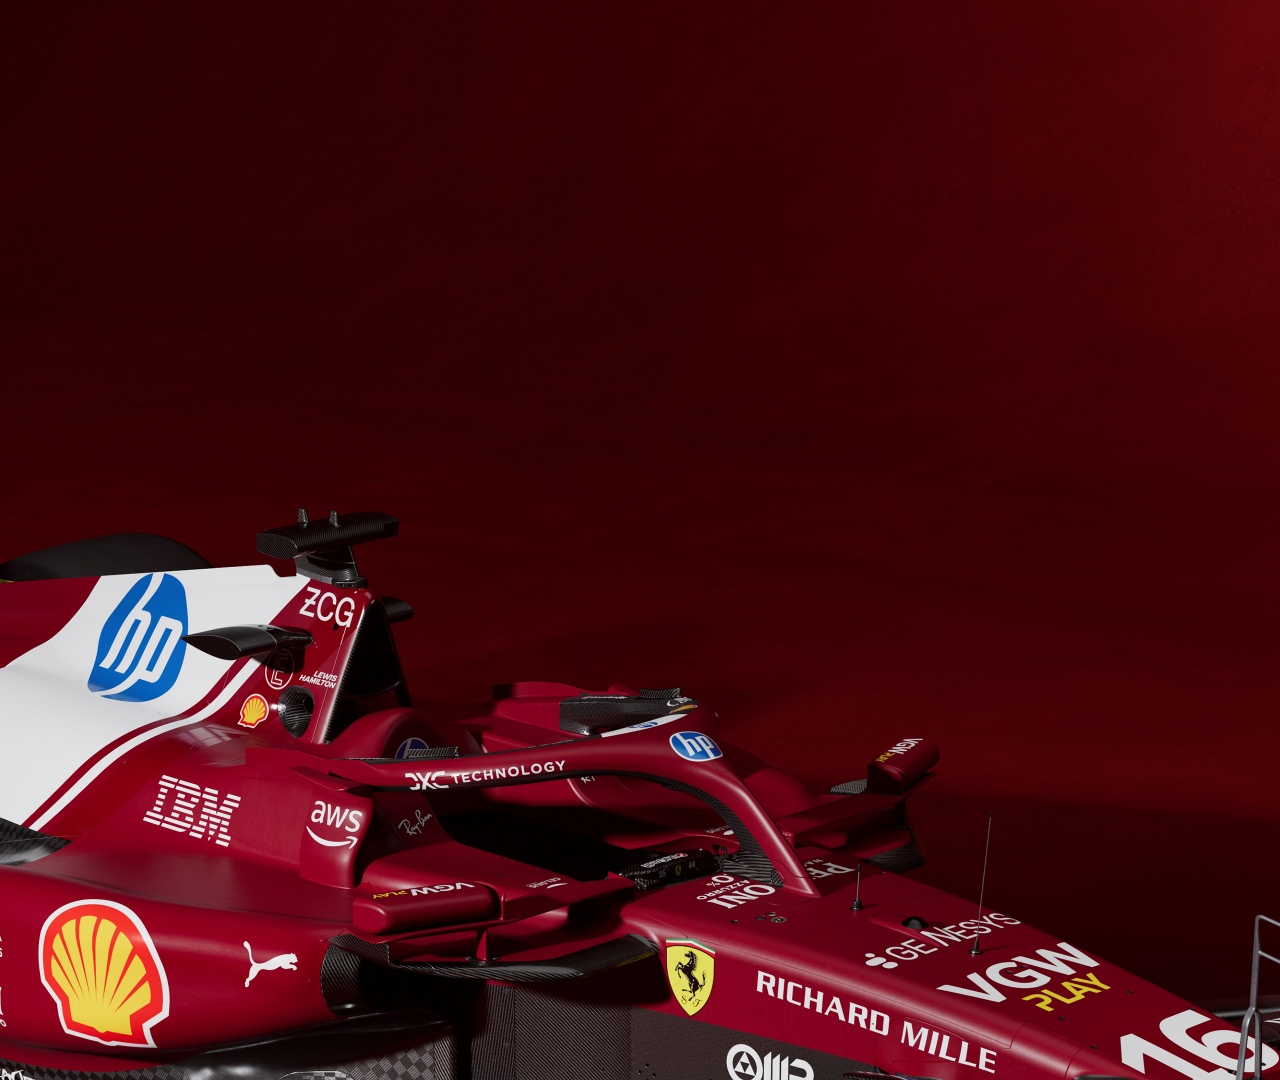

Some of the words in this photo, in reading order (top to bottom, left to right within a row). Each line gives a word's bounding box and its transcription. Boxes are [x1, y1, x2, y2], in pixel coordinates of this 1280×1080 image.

[90, 572, 184, 697] hp
[298, 674, 337, 689] HAMILTON
[314, 670, 338, 682] LEWIS
[674, 732, 717, 760] hp
[405, 770, 449, 791] DXC
[450, 760, 566, 784] TECHNOLOGY
[143, 774, 241, 847] IBM
[310, 800, 363, 832] aws
[410, 881, 476, 896] VGW
[885, 912, 1022, 961] GENESYS
[936, 941, 1101, 1004] VGW
[1021, 971, 1111, 1013] PLAY
[756, 970, 890, 1037] RICHARD
[900, 1020, 998, 1074] MILLE
